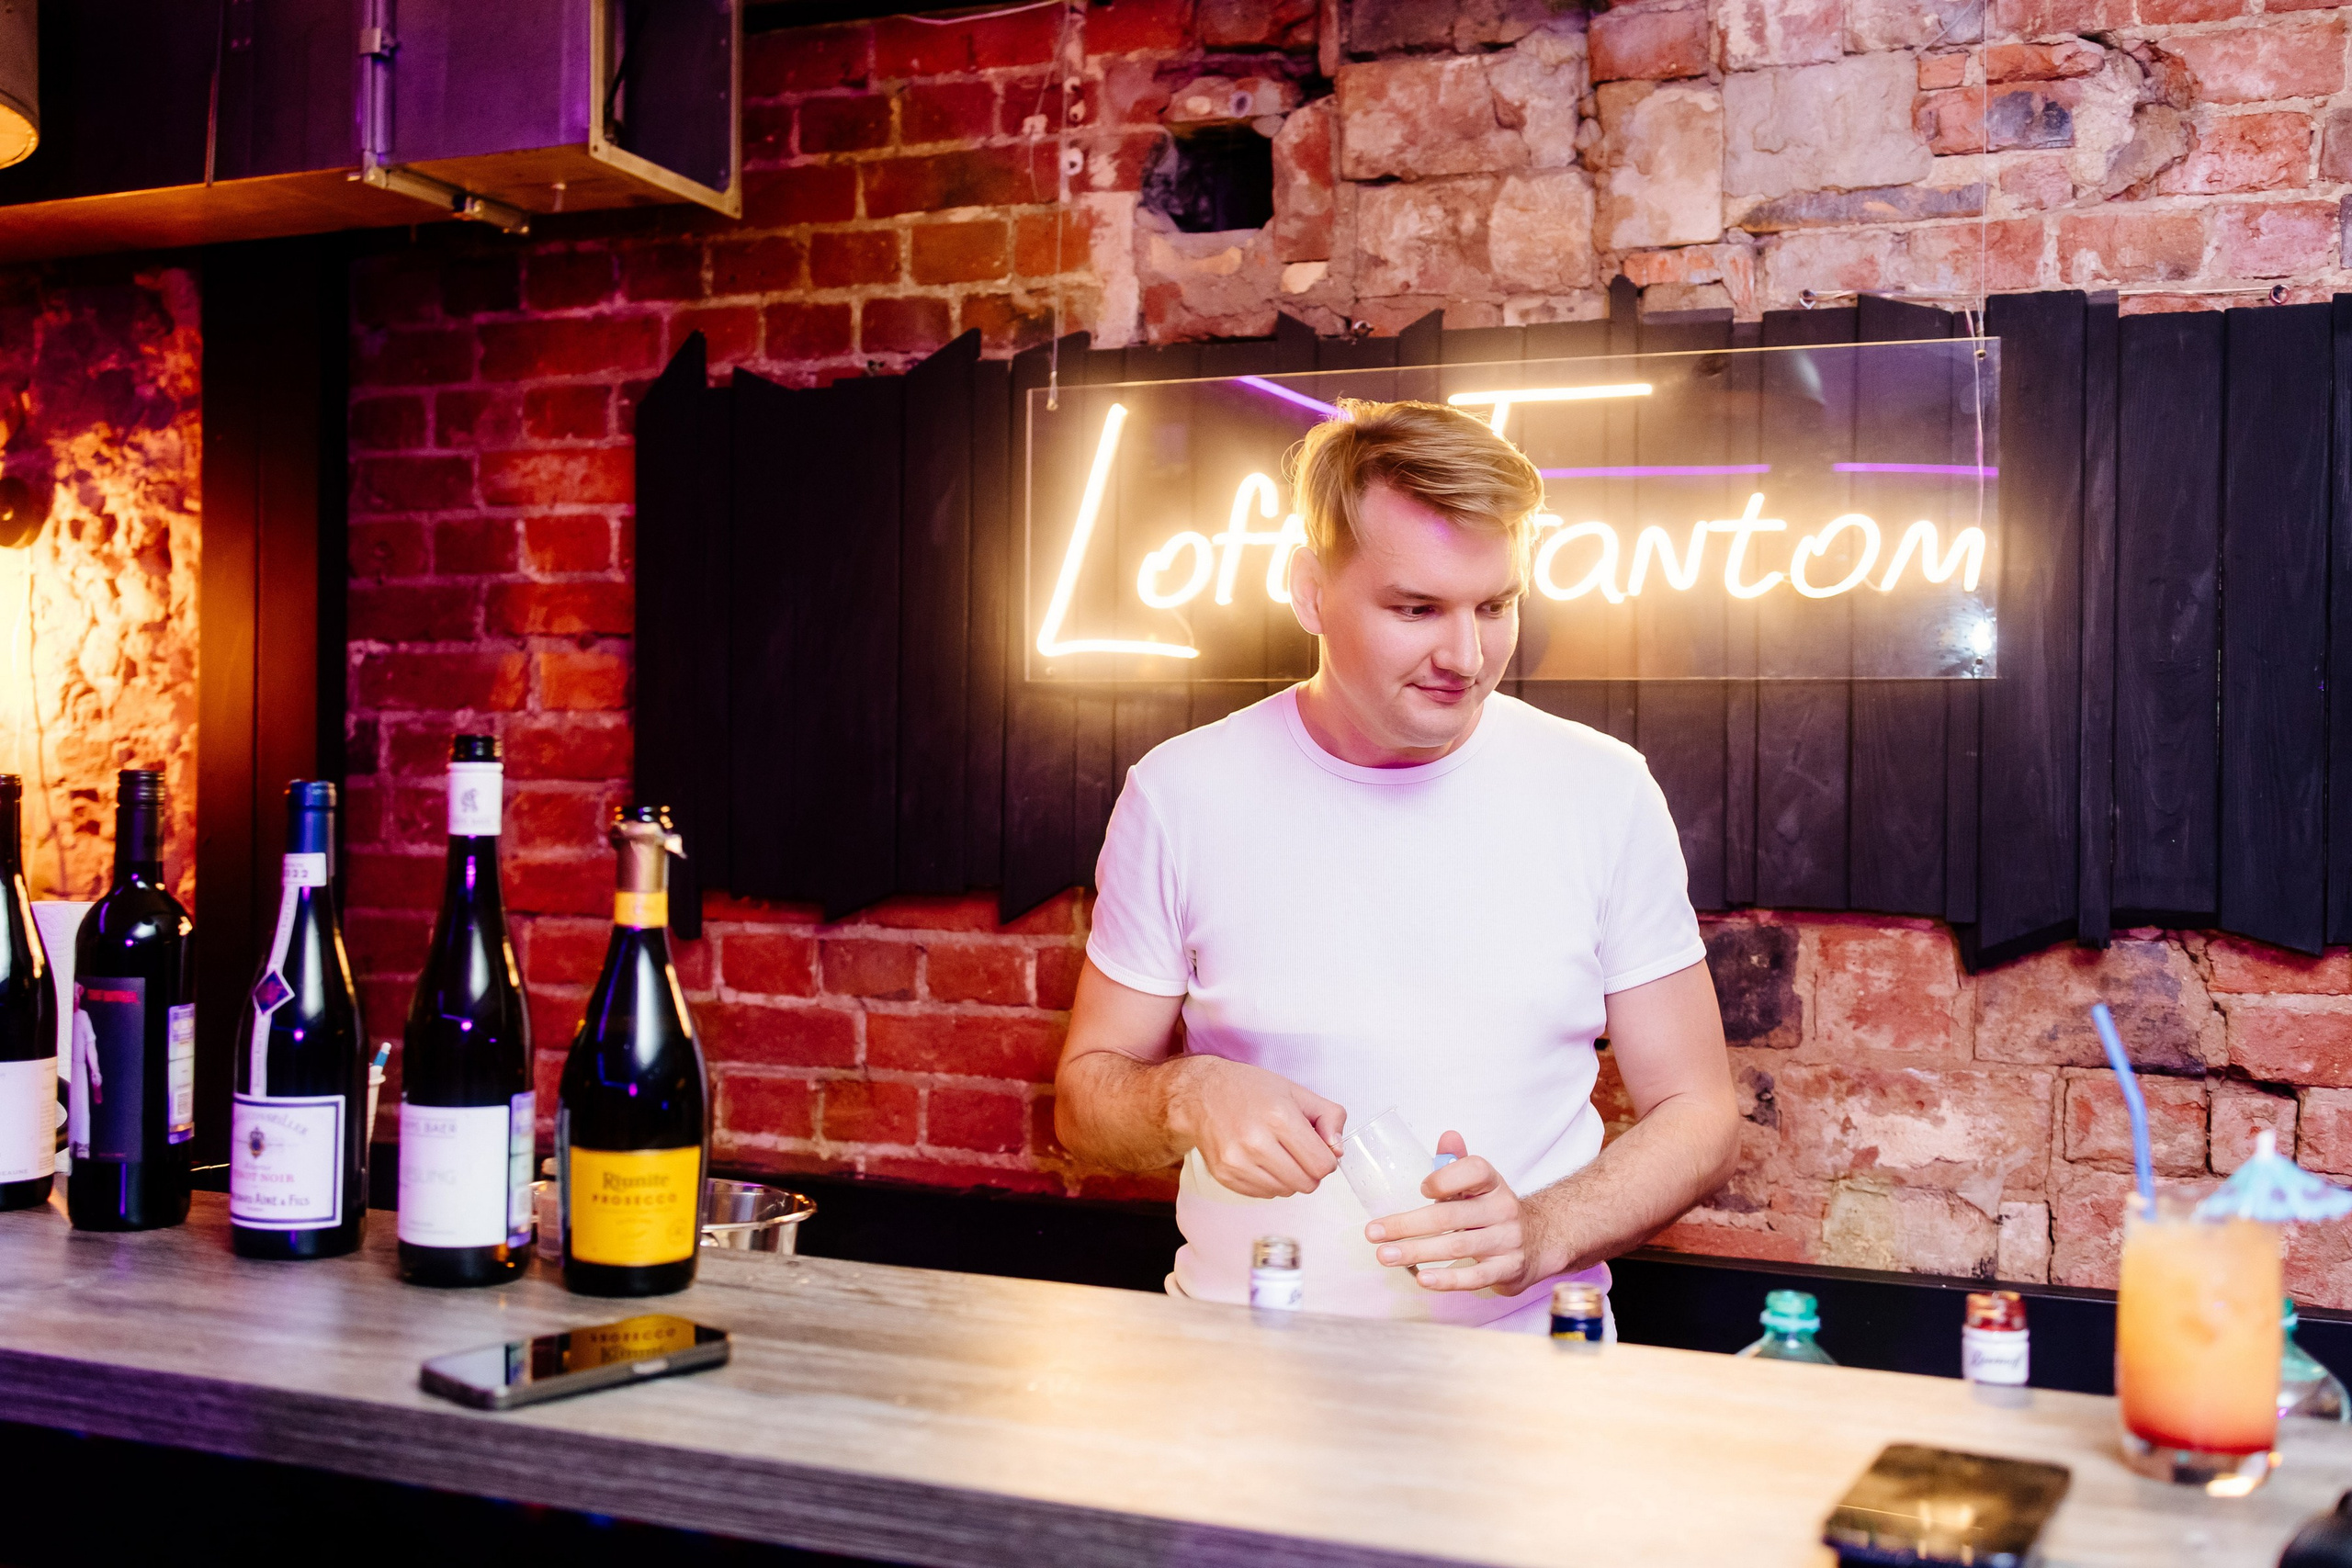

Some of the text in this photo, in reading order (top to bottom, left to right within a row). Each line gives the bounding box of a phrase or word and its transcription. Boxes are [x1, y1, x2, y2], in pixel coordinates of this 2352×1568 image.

[1035, 401, 1308, 660] Loft
[0, 1168, 28, 1176] EAUNE
[260, 1172, 296, 1184] NOIR
[602, 1170, 671, 1193] Riunite
[591, 1192, 677, 1206] PROSECCO
